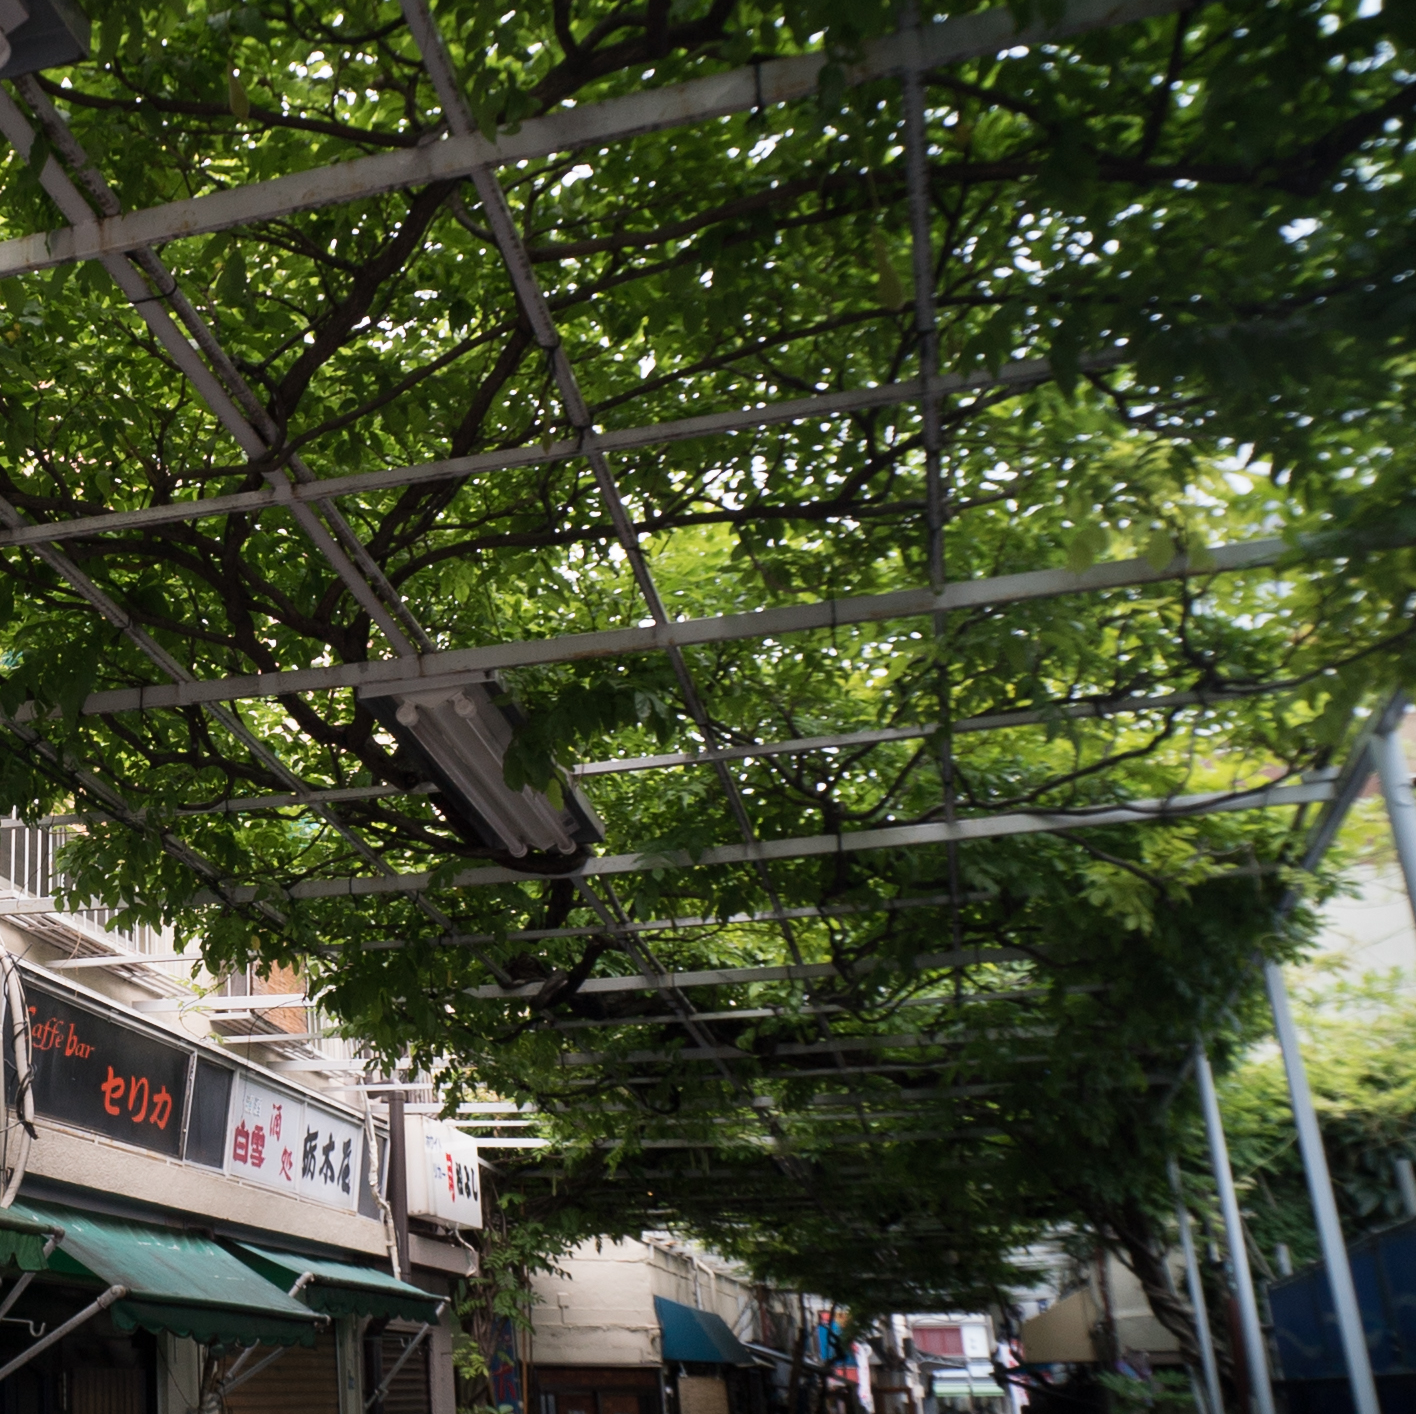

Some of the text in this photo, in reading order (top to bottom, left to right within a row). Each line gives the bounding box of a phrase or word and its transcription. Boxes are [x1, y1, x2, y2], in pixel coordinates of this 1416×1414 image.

[64, 1023, 95, 1060] bar
[100, 1065, 173, 1130] セリカ
[232, 1119, 266, 1169] 白雪
